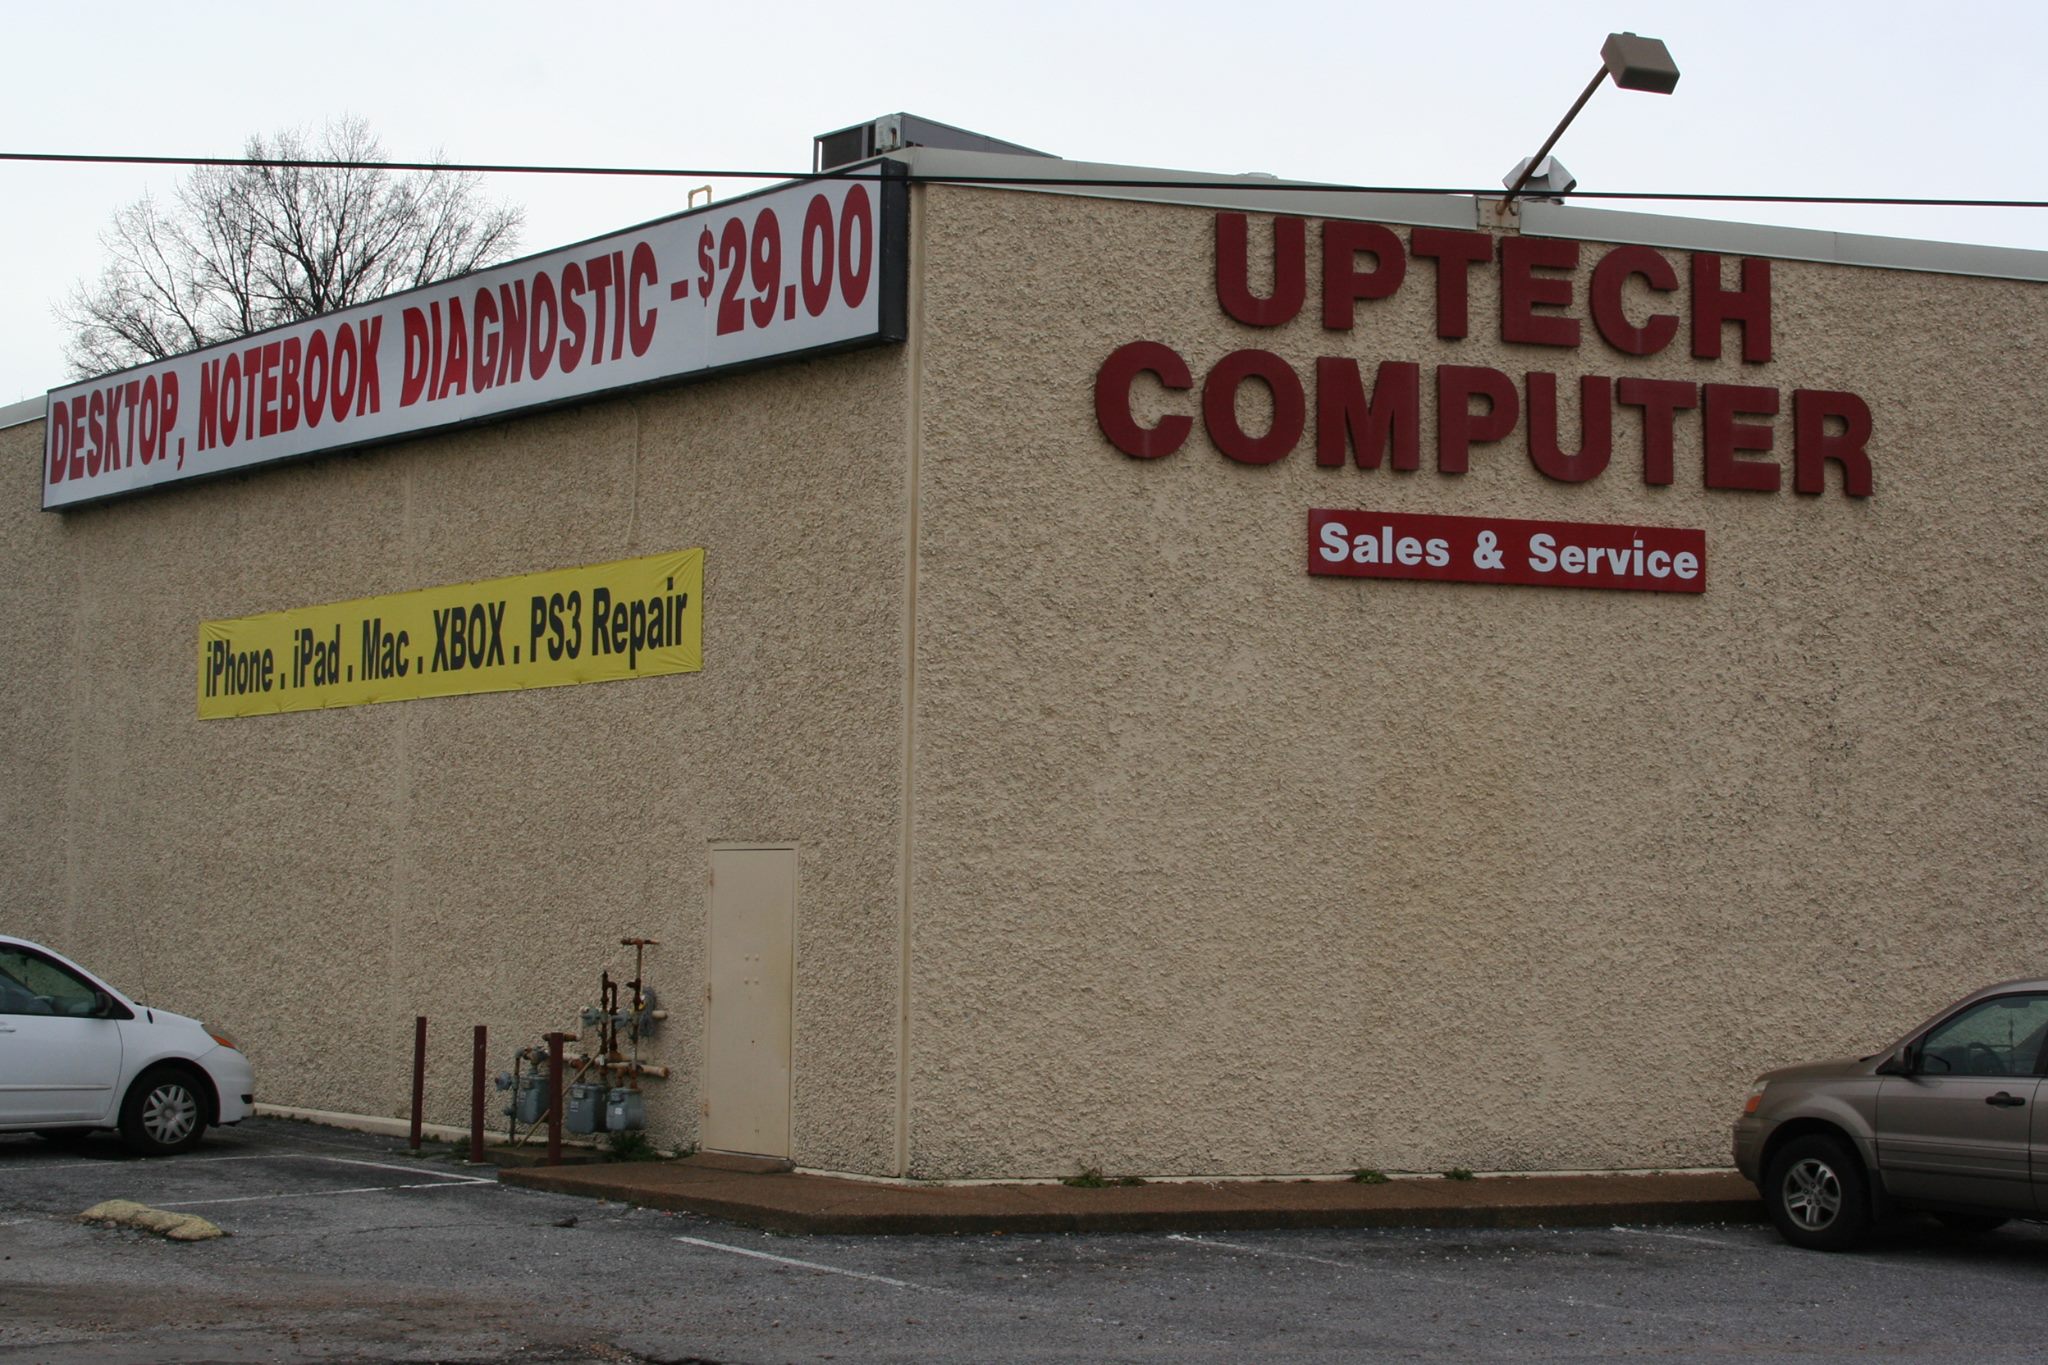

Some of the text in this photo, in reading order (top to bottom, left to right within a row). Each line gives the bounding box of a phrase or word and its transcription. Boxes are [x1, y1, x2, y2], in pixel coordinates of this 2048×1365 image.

[50, 371, 185, 485] DESKTOP,
[197, 315, 382, 451] NOTEBOOK
[399, 241, 659, 407] DIAGNOSTIC
[1215, 212, 1772, 363] UPTECH
[1094, 341, 1874, 497] COMPUTER
[1319, 522, 1698, 579] Sales & Service
[205, 640, 273, 697] iPhone
[293, 624, 341, 688] iPad
[361, 618, 409, 681] Mac
[431, 601, 506, 673] XBOX
[530, 591, 582, 662] PS3
[592, 577, 688, 670] Repair
